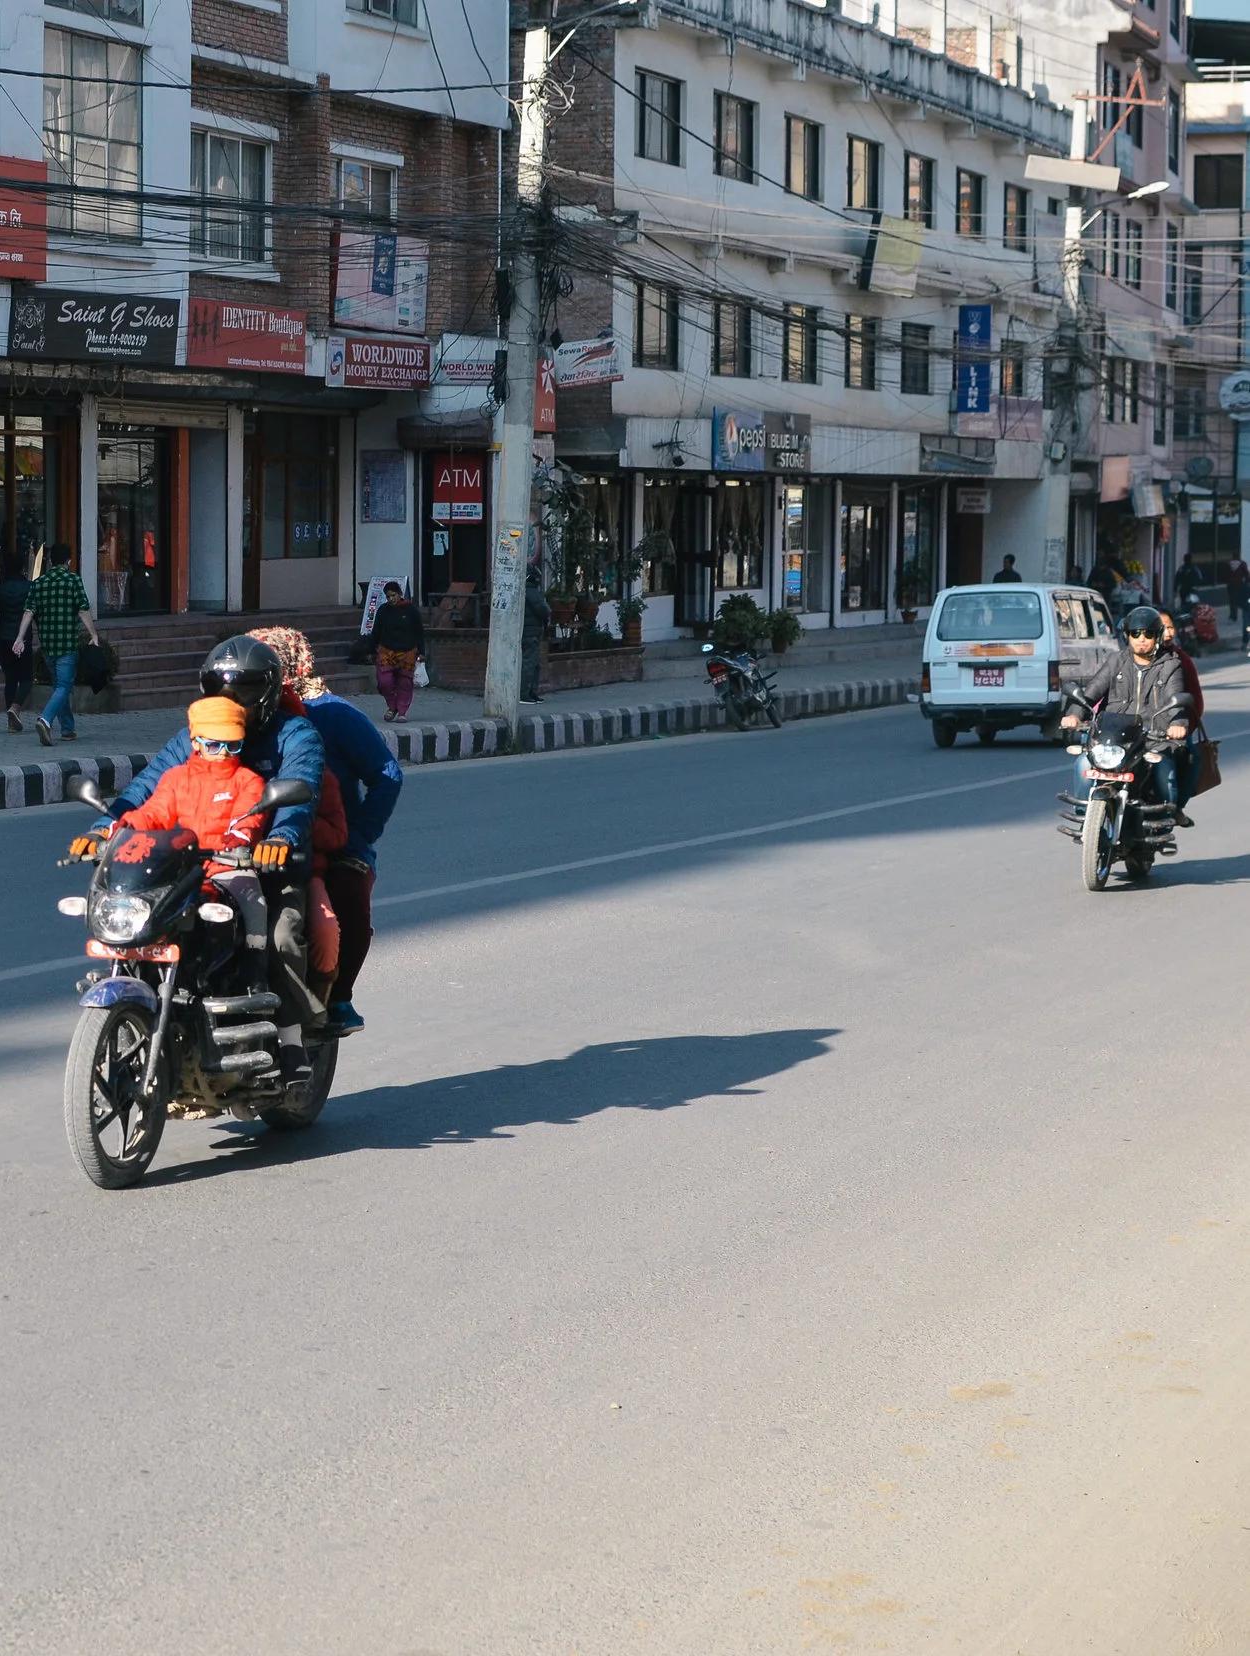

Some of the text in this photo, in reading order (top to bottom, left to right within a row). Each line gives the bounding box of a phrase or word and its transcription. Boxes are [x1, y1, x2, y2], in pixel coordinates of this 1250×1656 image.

[58, 300, 174, 332] Saint G Shoes
[222, 306, 303, 340] IDENTITY Boutique
[352, 343, 425, 367] WORLDWIDE
[346, 365, 429, 381] MONEY EXCHANGE
[440, 363, 496, 371] WORLD WID
[540, 408, 555, 423] ATM
[739, 425, 766, 453] pepsi
[771, 433, 791, 450] BLUE
[781, 453, 805, 468] STORE
[438, 469, 480, 488] ATM
